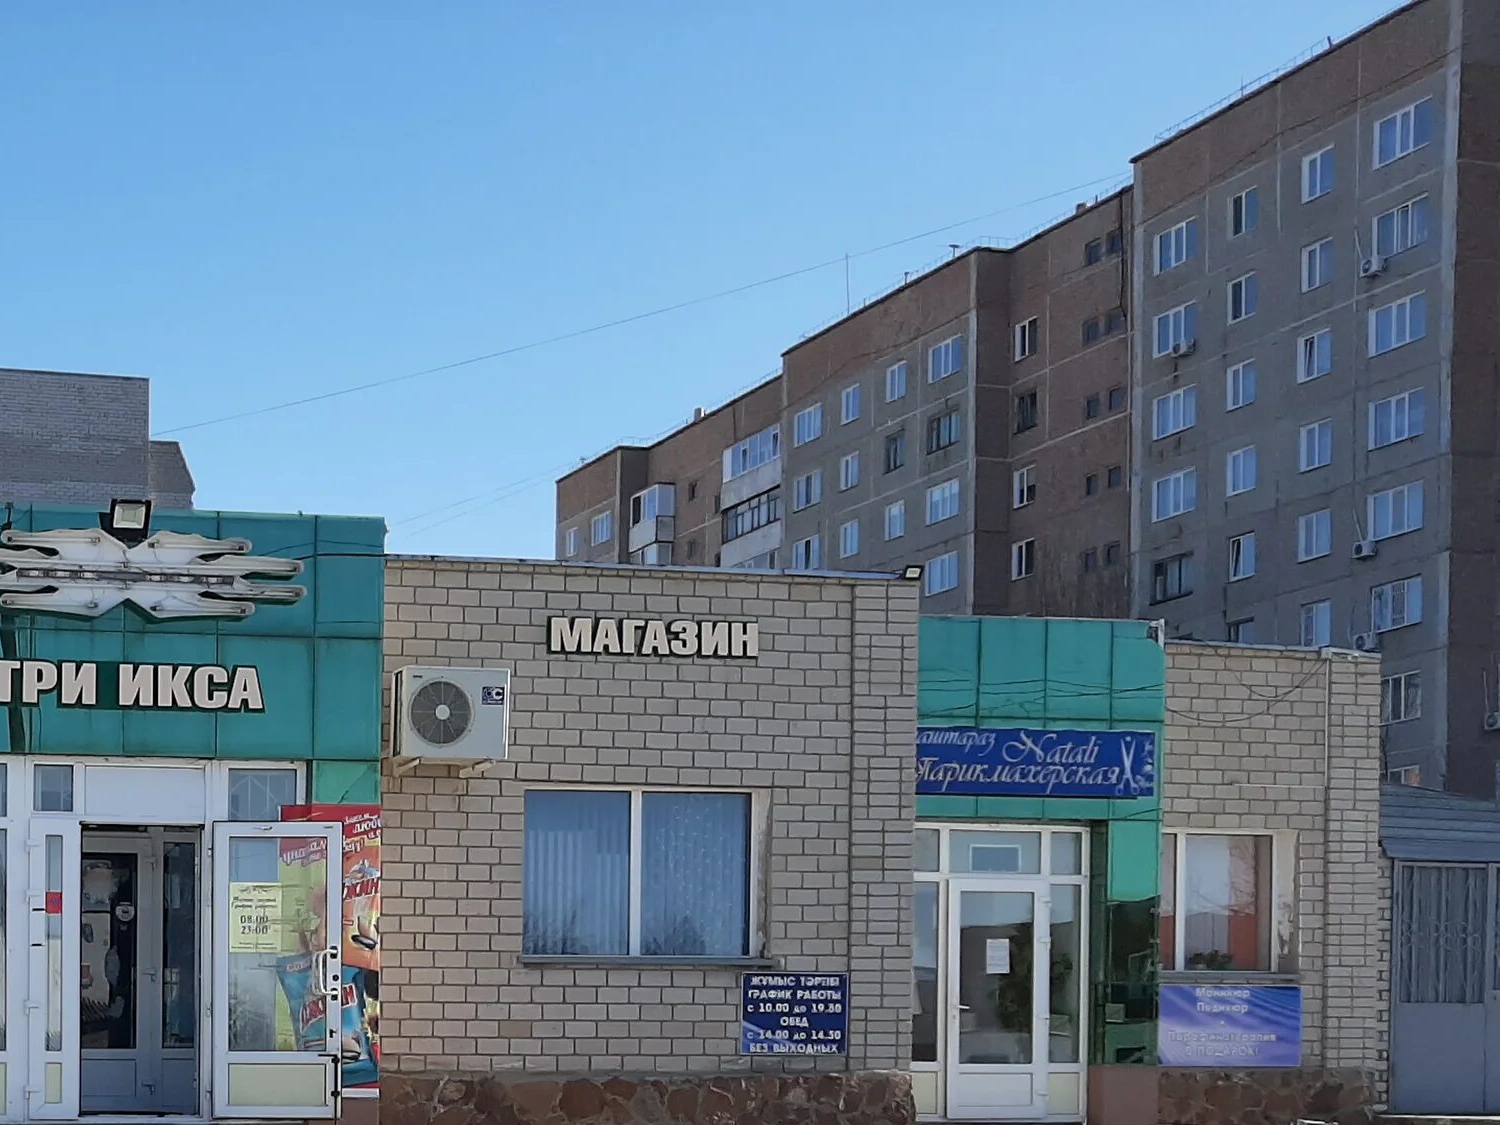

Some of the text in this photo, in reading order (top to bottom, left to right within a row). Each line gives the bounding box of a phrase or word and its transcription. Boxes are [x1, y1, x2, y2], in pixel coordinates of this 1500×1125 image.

[549, 616, 759, 657] МАГАЗИН
[118, 663, 263, 709] ИКСА
[916, 730, 996, 757] аштараз
[1002, 730, 1102, 763] Natali
[916, 757, 1120, 793] Парикмахерская
[748, 989, 842, 1000] ГРАФИК РАБОТЫ
[759, 1003, 790, 1012] 10.00
[780, 1016, 809, 1027] ОБЕД
[749, 1043, 839, 1055] БЕЗ ВЫХОДНЫХ
